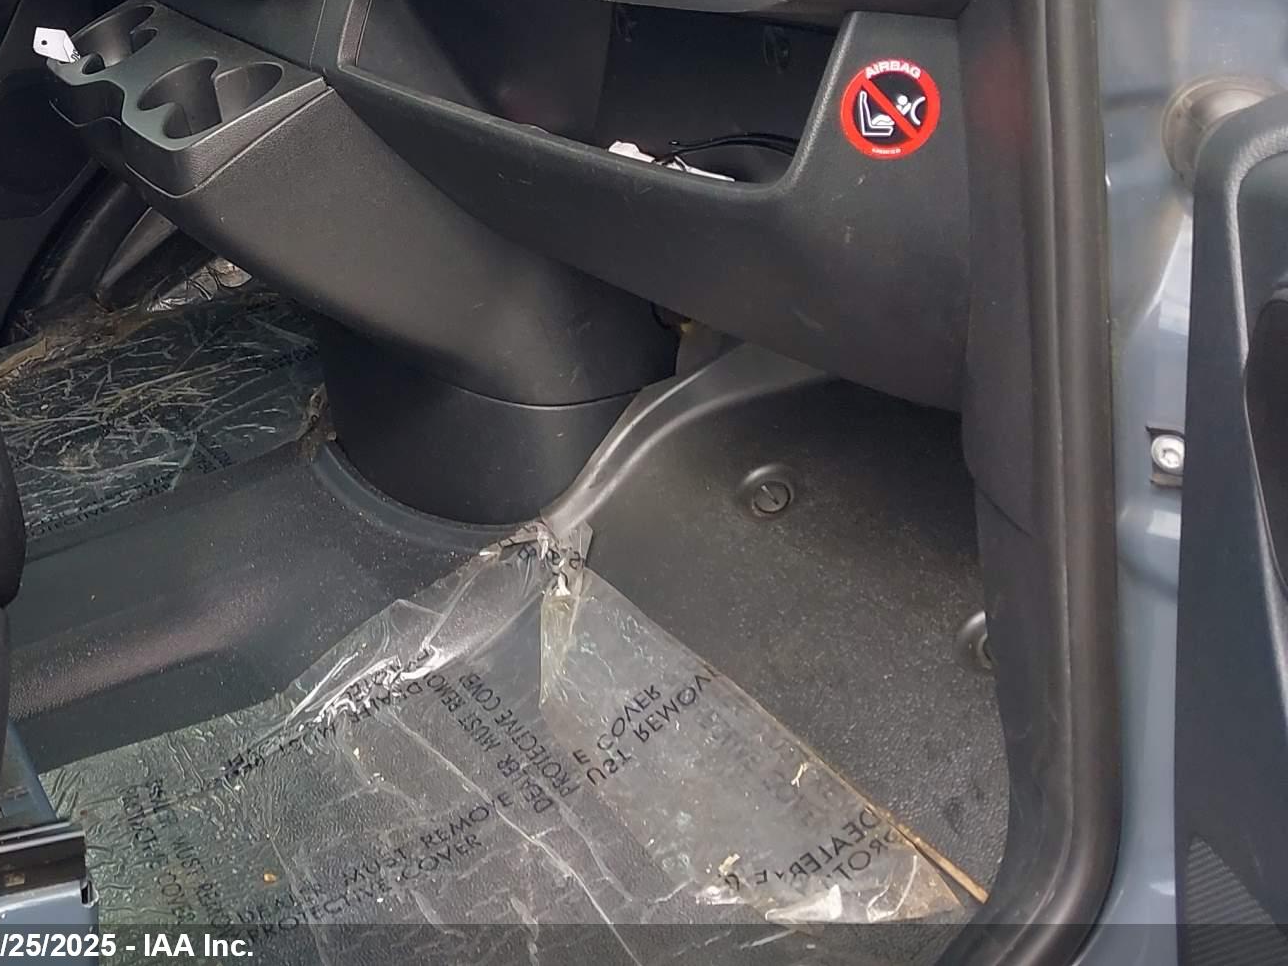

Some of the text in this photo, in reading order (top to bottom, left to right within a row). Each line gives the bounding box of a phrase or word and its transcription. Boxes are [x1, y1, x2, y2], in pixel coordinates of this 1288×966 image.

[865, 60, 921, 79] AIRBAG
[423, 672, 466, 713] REMO
[402, 834, 483, 880] COVER
